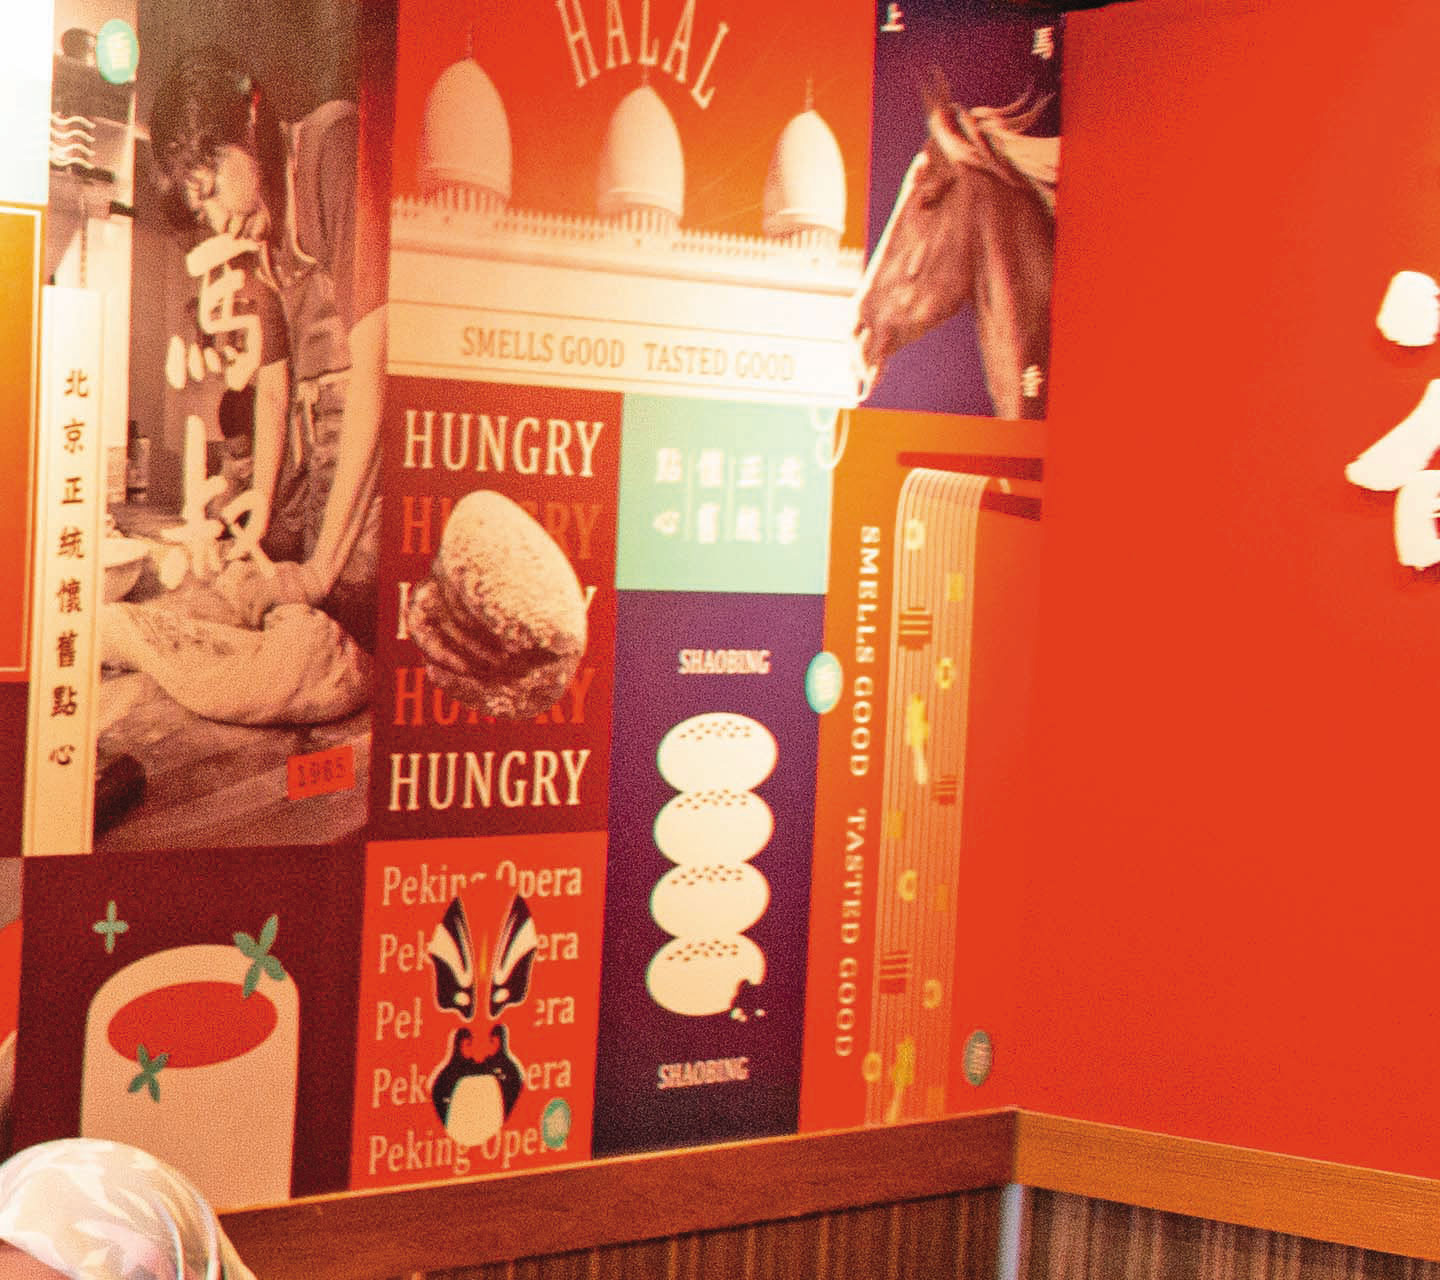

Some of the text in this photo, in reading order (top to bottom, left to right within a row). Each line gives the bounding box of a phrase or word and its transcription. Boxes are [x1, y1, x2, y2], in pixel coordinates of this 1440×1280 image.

[881, 2, 905, 32] 上
[461, 325, 795, 381] SMELLS GOOD TASTED GOOD
[403, 409, 604, 478] HUNGRY
[849, 676, 874, 778] GOOD
[388, 749, 592, 811] HUNGRY
[835, 958, 857, 1058] GOOD
